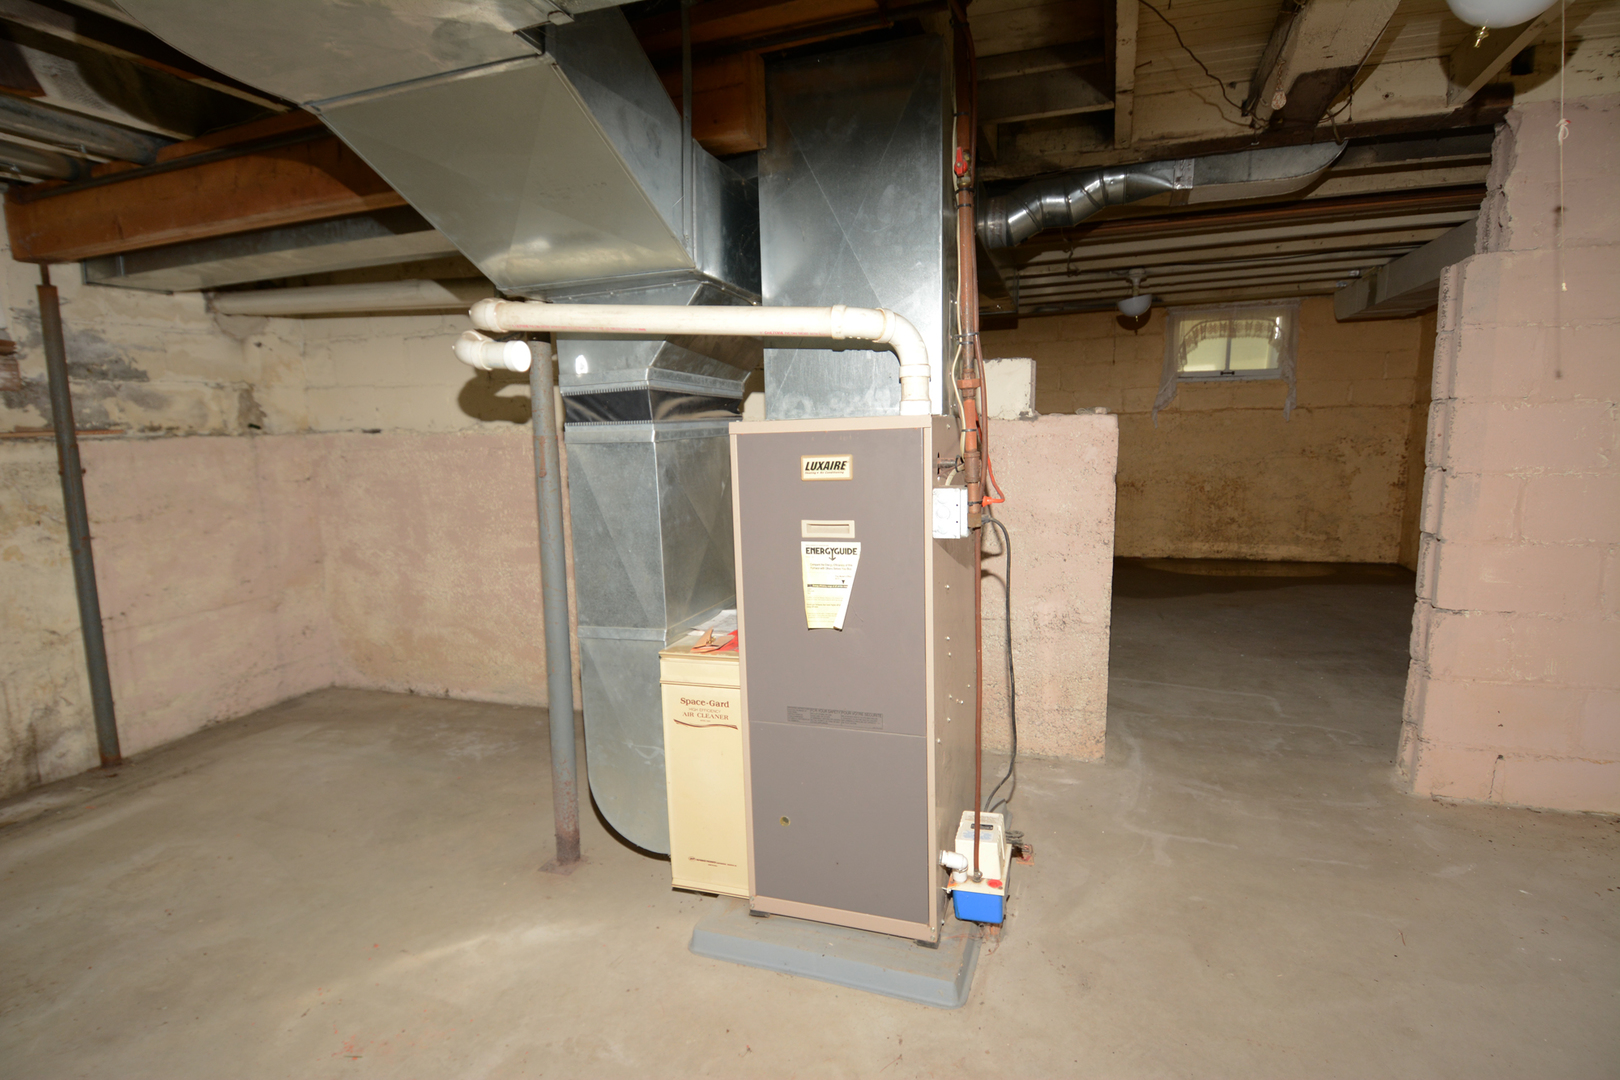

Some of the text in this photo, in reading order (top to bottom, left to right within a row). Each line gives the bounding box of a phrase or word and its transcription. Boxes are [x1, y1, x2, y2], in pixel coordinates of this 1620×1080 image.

[805, 461, 847, 471] LUXAIRE
[805, 547, 858, 557] ENERGYGUIDE
[680, 697, 730, 708] Space-Gard
[697, 712, 729, 720] CLEANER
